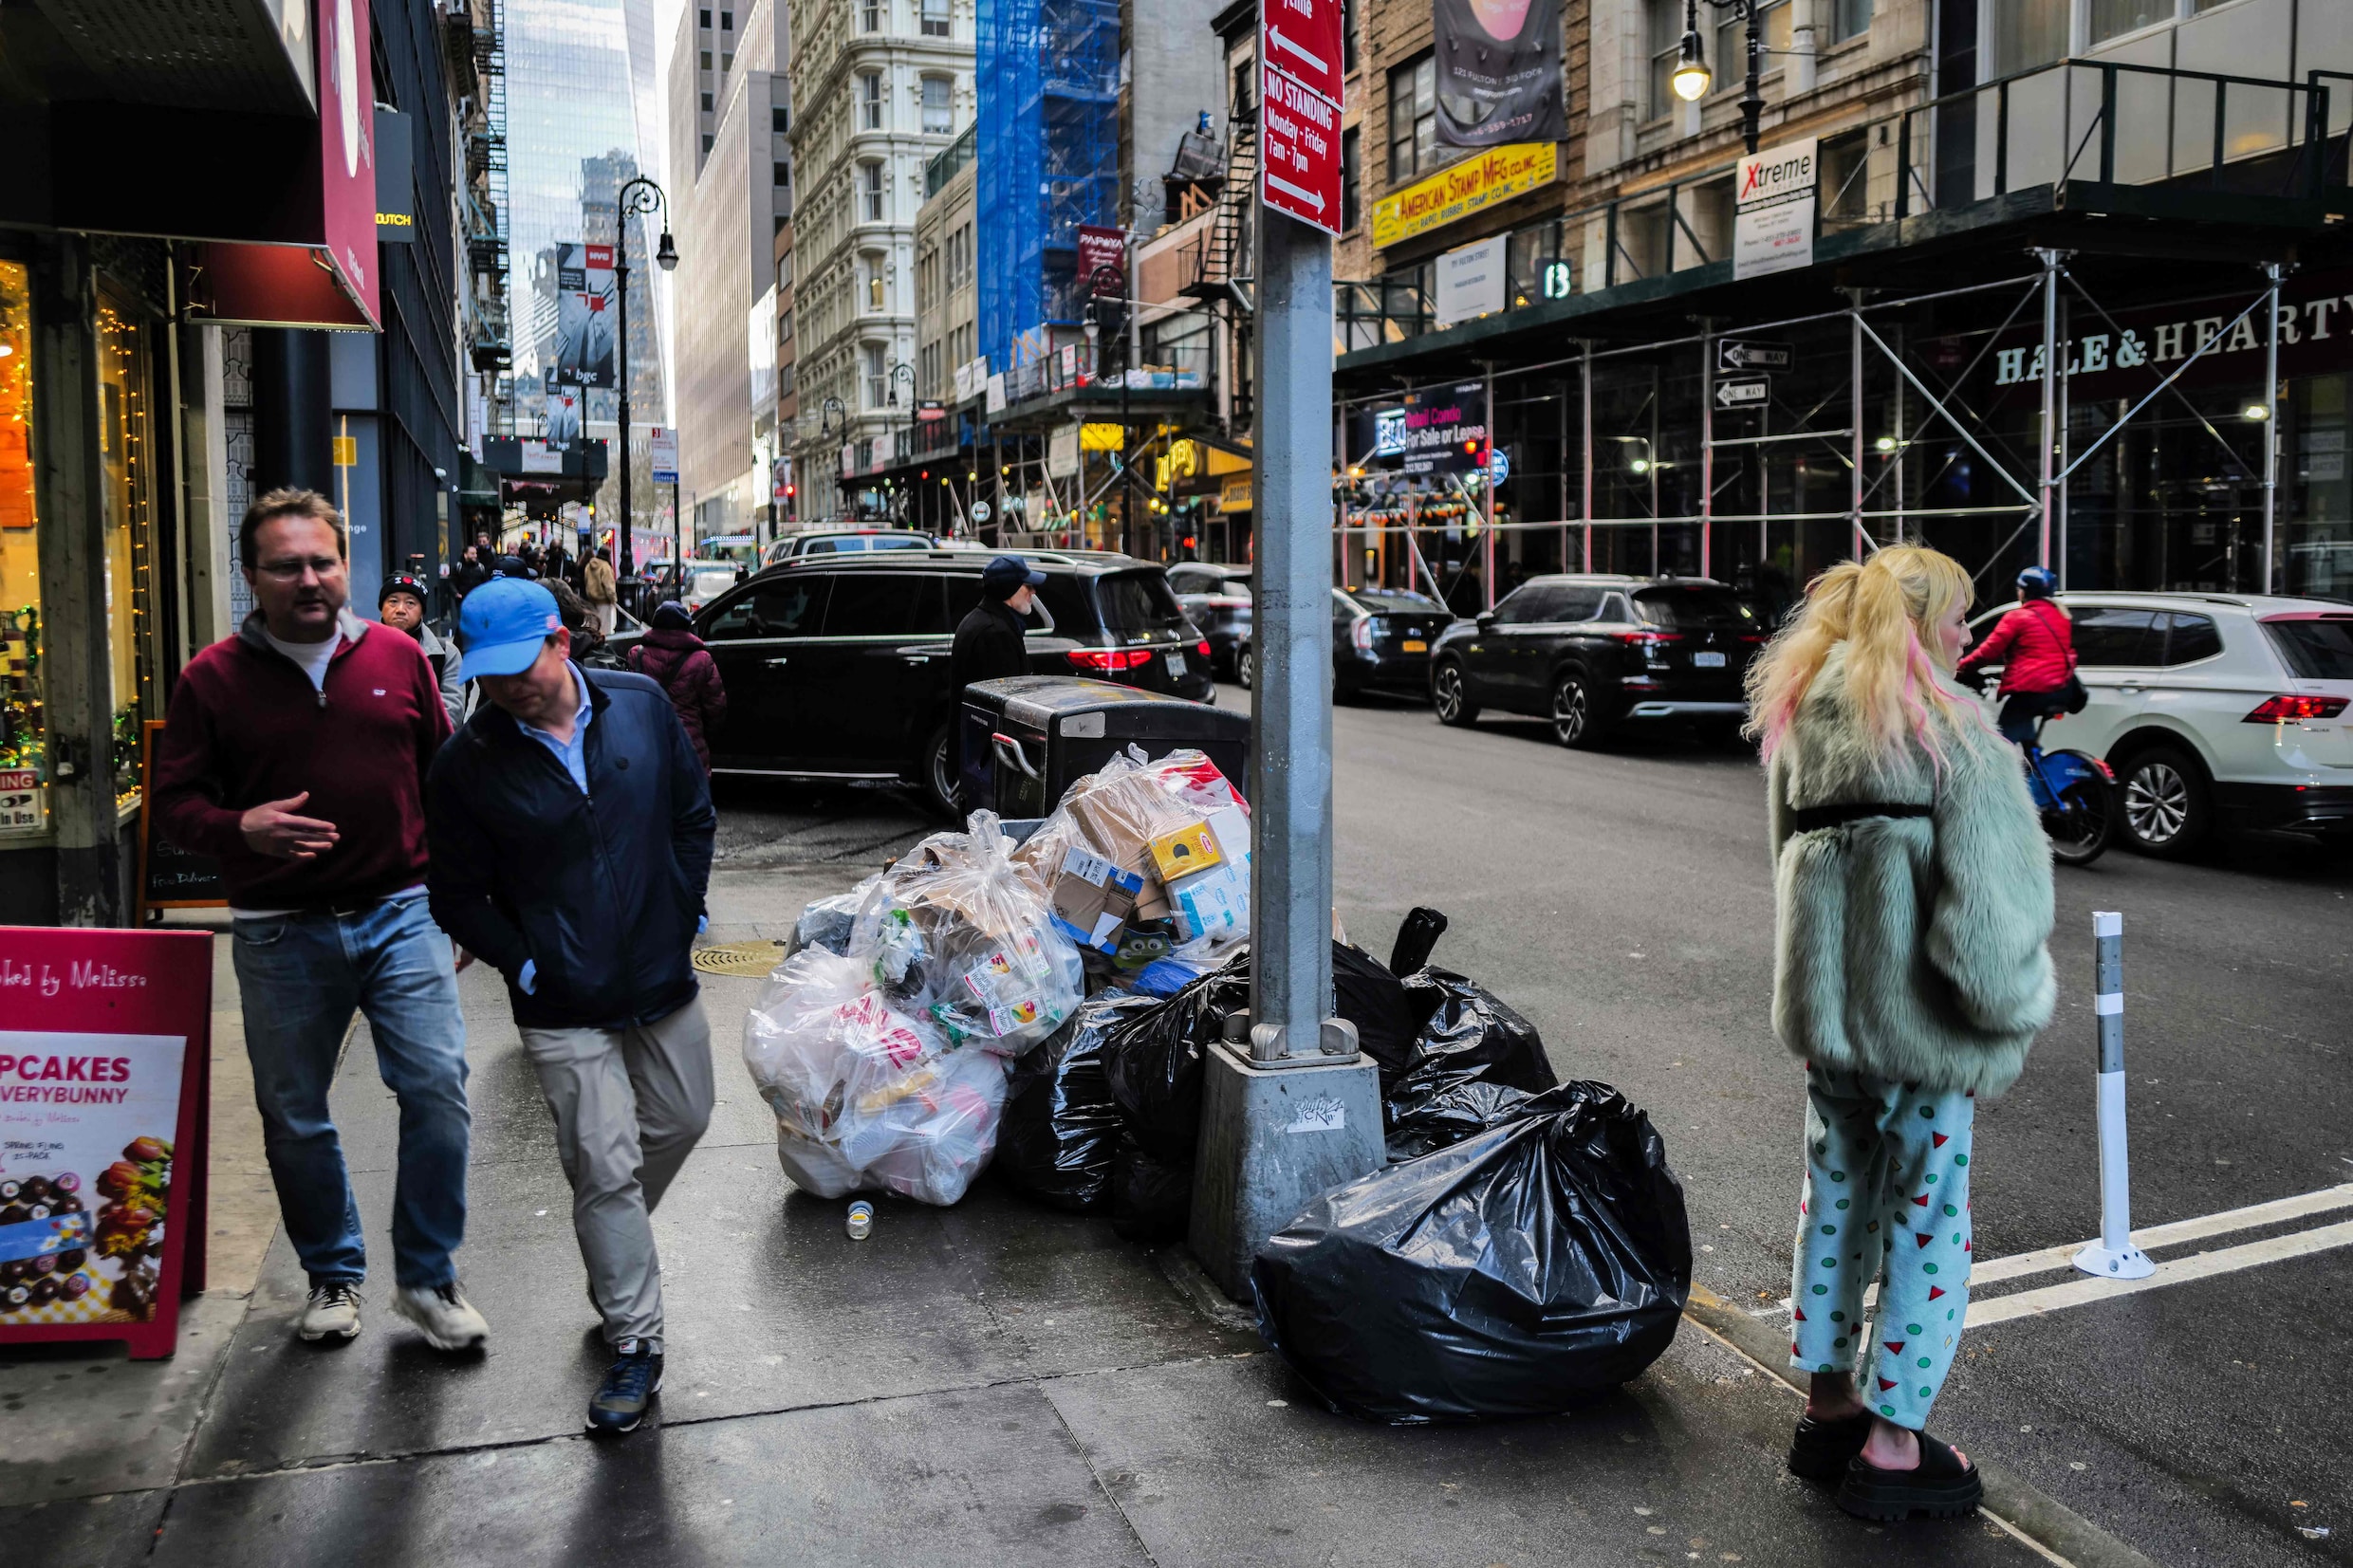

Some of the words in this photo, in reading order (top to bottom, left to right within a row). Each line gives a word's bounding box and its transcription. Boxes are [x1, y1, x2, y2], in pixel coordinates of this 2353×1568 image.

[1283, 0, 1313, 19] time
[1268, 71, 1283, 102] NO
[1286, 83, 1333, 131] STANDING
[1268, 106, 1298, 145] Monday
[1305, 126, 1327, 160] Friday
[1269, 134, 1286, 162] 7am
[1291, 146, 1308, 174] 7pm
[1401, 184, 1447, 223] AMERICAN
[1449, 170, 1480, 202] STAMP
[1483, 155, 1508, 189] MFG
[1741, 155, 1811, 199] Xtreme
[1468, 193, 1489, 210] STAMP
[374, 212, 412, 227] DUTCH
[1732, 349, 1752, 361] ONE
[1765, 351, 1786, 364] WAY
[576, 368, 598, 383] bgc
[1723, 388, 1738, 399] ONE
[1746, 386, 1763, 397] WAY
[1405, 409, 1430, 428] Retail
[1431, 404, 1462, 425] Condo
[1406, 432, 1419, 449] For
[1419, 426, 1440, 448] Sale
[1442, 428, 1454, 446] or
[1454, 424, 1486, 443] Lease
[1, 812, 11, 825] In
[14, 811, 35, 825] Use
[40, 964, 61, 996] by
[69, 959, 148, 989] Melissa
[0, 1054, 132, 1082] PCAKES
[0, 1085, 129, 1104] VERYBUNNY
